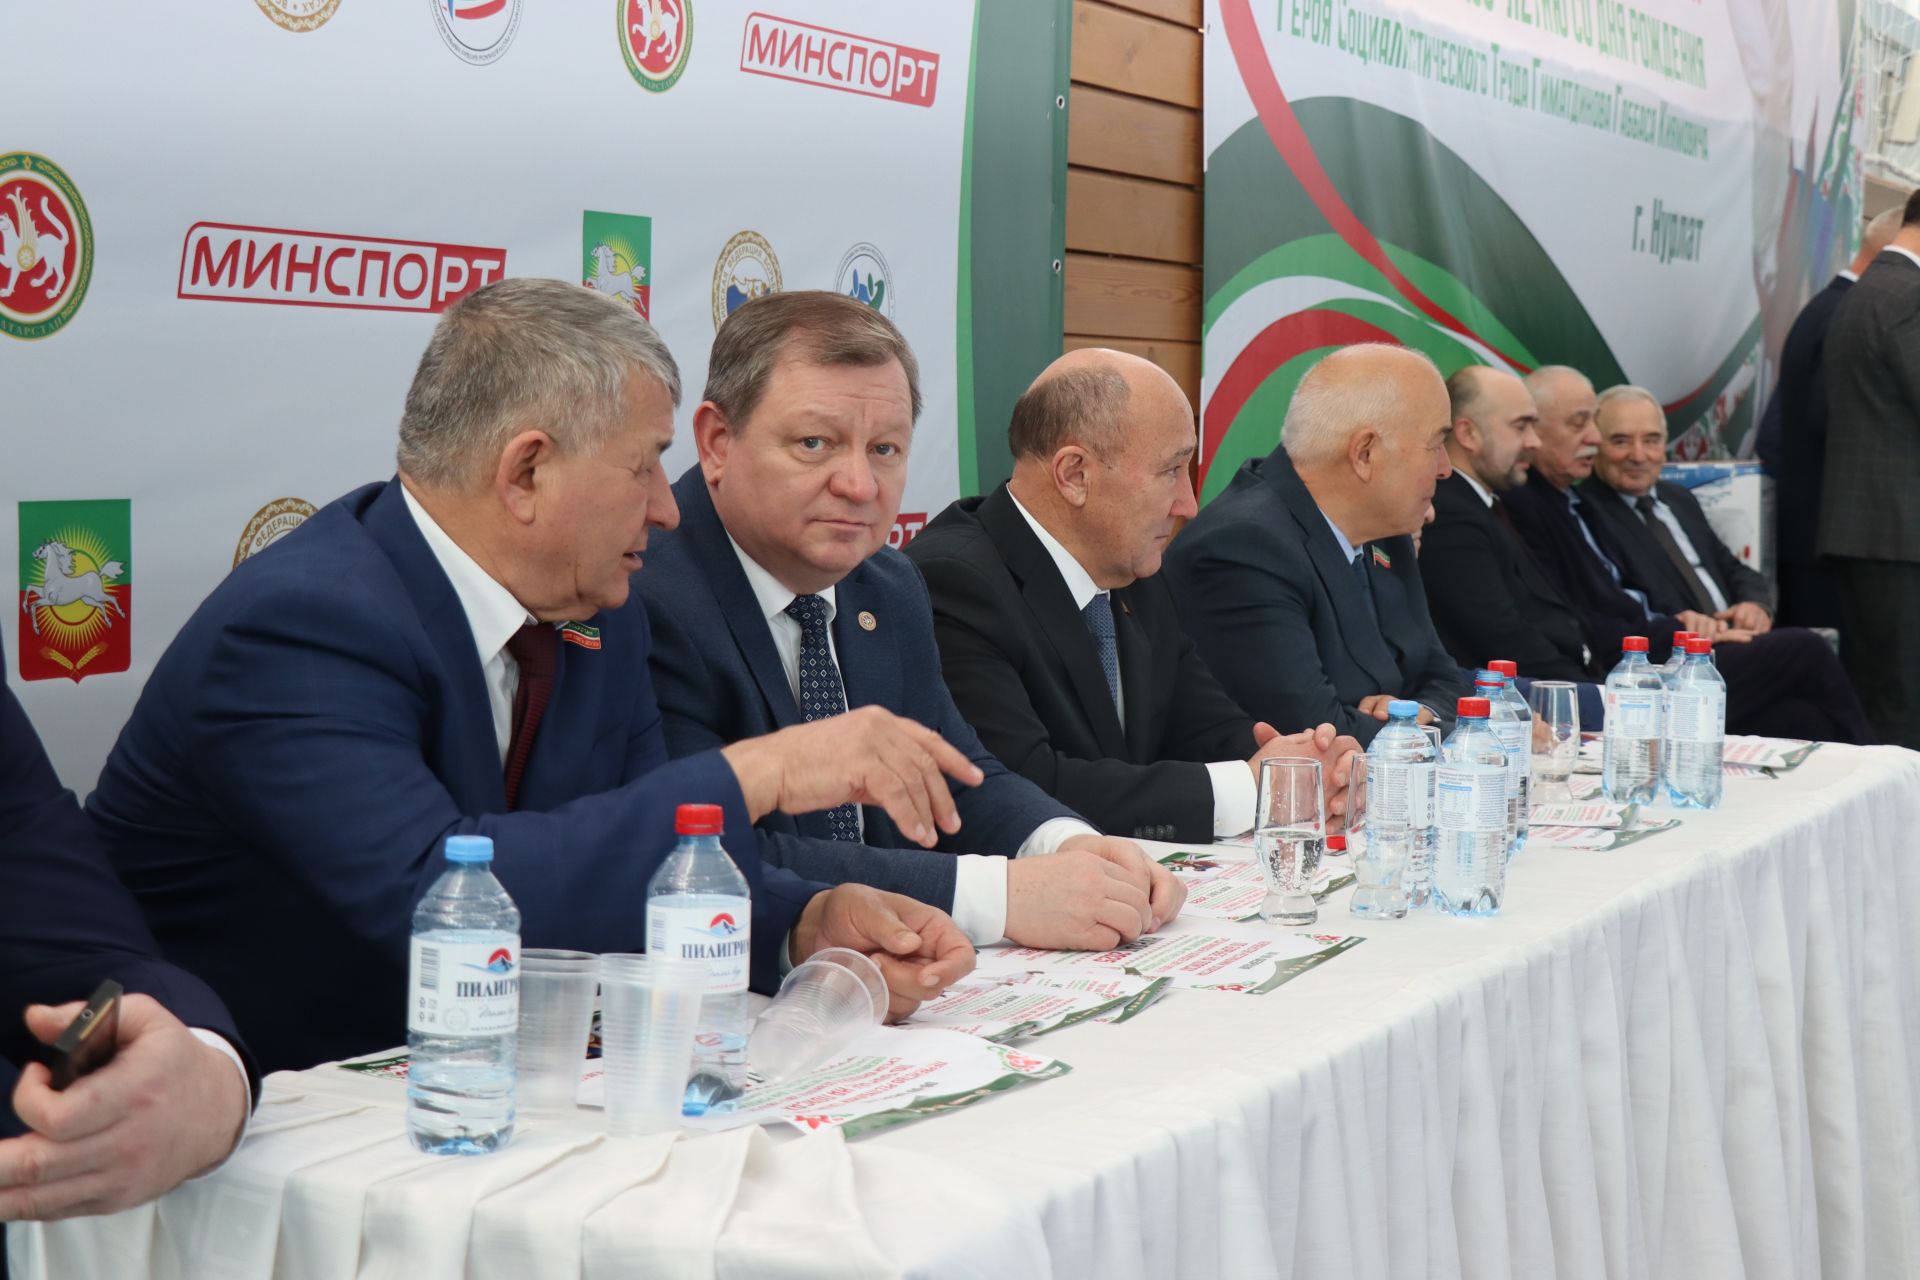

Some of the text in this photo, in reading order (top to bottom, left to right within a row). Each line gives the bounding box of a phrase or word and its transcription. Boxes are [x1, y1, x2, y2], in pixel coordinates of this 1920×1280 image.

[747, 22, 937, 98] МИНСПОРТ
[1629, 8, 1707, 90] РОЖДЕНИЯ
[1631, 205, 1645, 252] г.
[190, 235, 501, 303] МИНСПОРТ
[0, 316, 63, 337] АТАРСТАН
